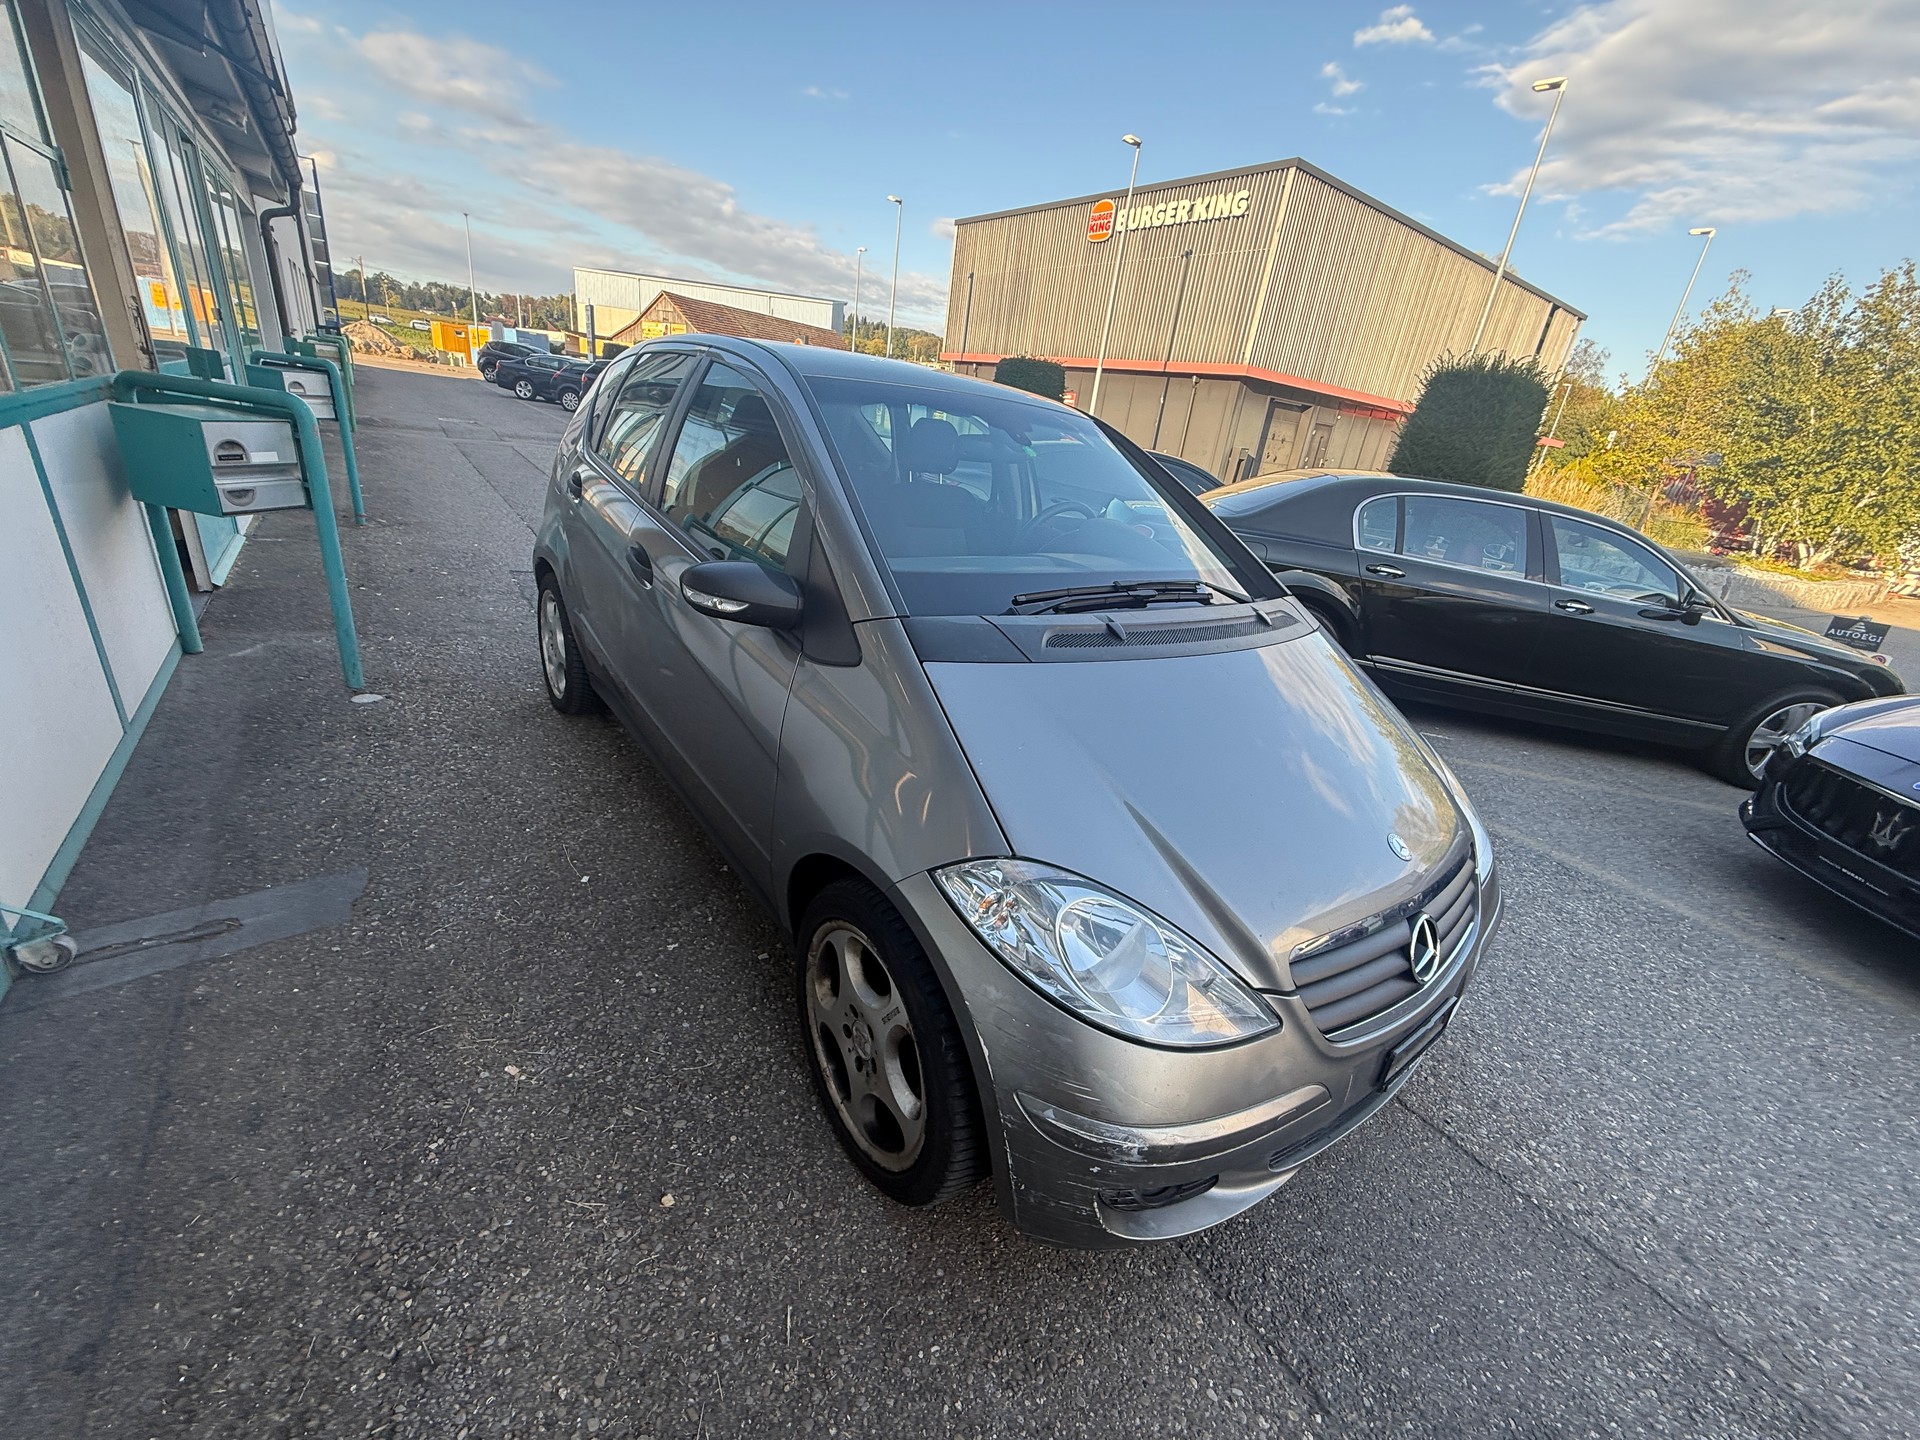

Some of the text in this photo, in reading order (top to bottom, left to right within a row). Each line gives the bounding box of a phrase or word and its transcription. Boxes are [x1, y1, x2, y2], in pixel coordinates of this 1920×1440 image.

[1091, 211, 1113, 222] BURGER
[1115, 189, 1250, 232] BURGER KING
[1089, 220, 1111, 233] KING
[1828, 627, 1884, 643] AUTOEGI
